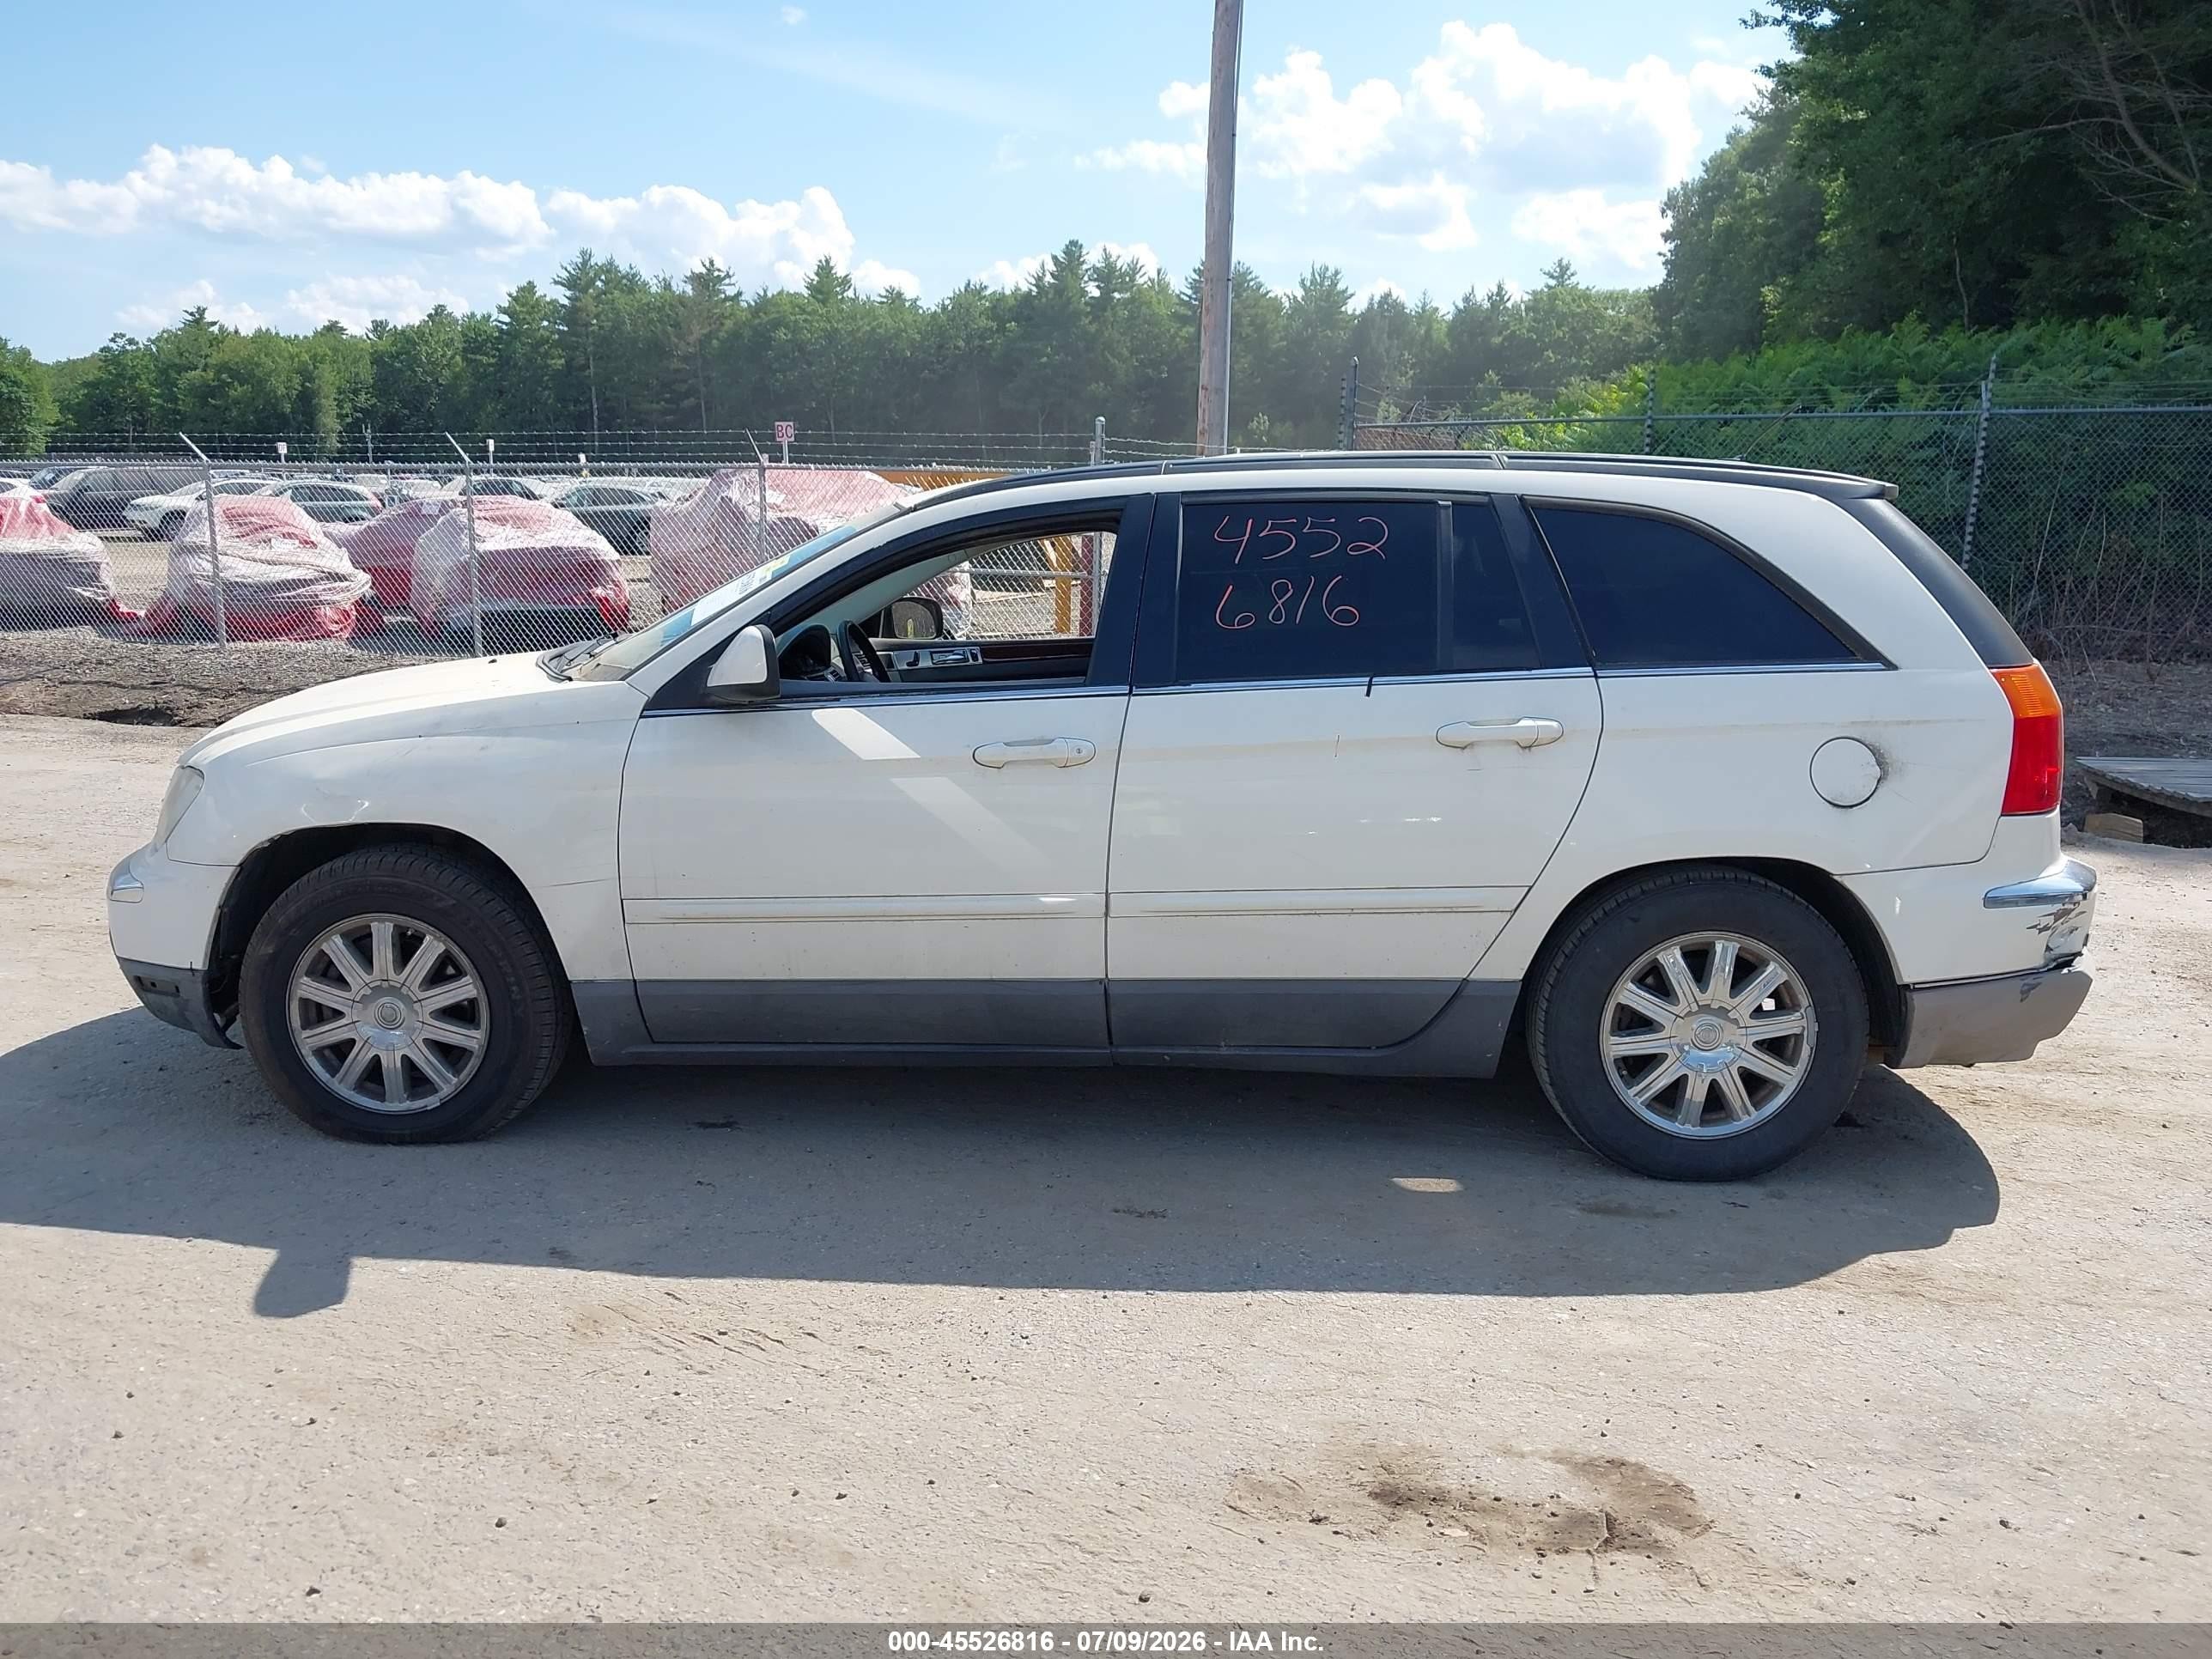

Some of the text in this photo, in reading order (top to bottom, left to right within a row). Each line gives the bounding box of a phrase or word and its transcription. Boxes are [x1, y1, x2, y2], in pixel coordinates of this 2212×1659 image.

[776, 424, 793, 439] BC
[1214, 515, 1389, 564] 4552
[1214, 575, 1360, 630] 6816
